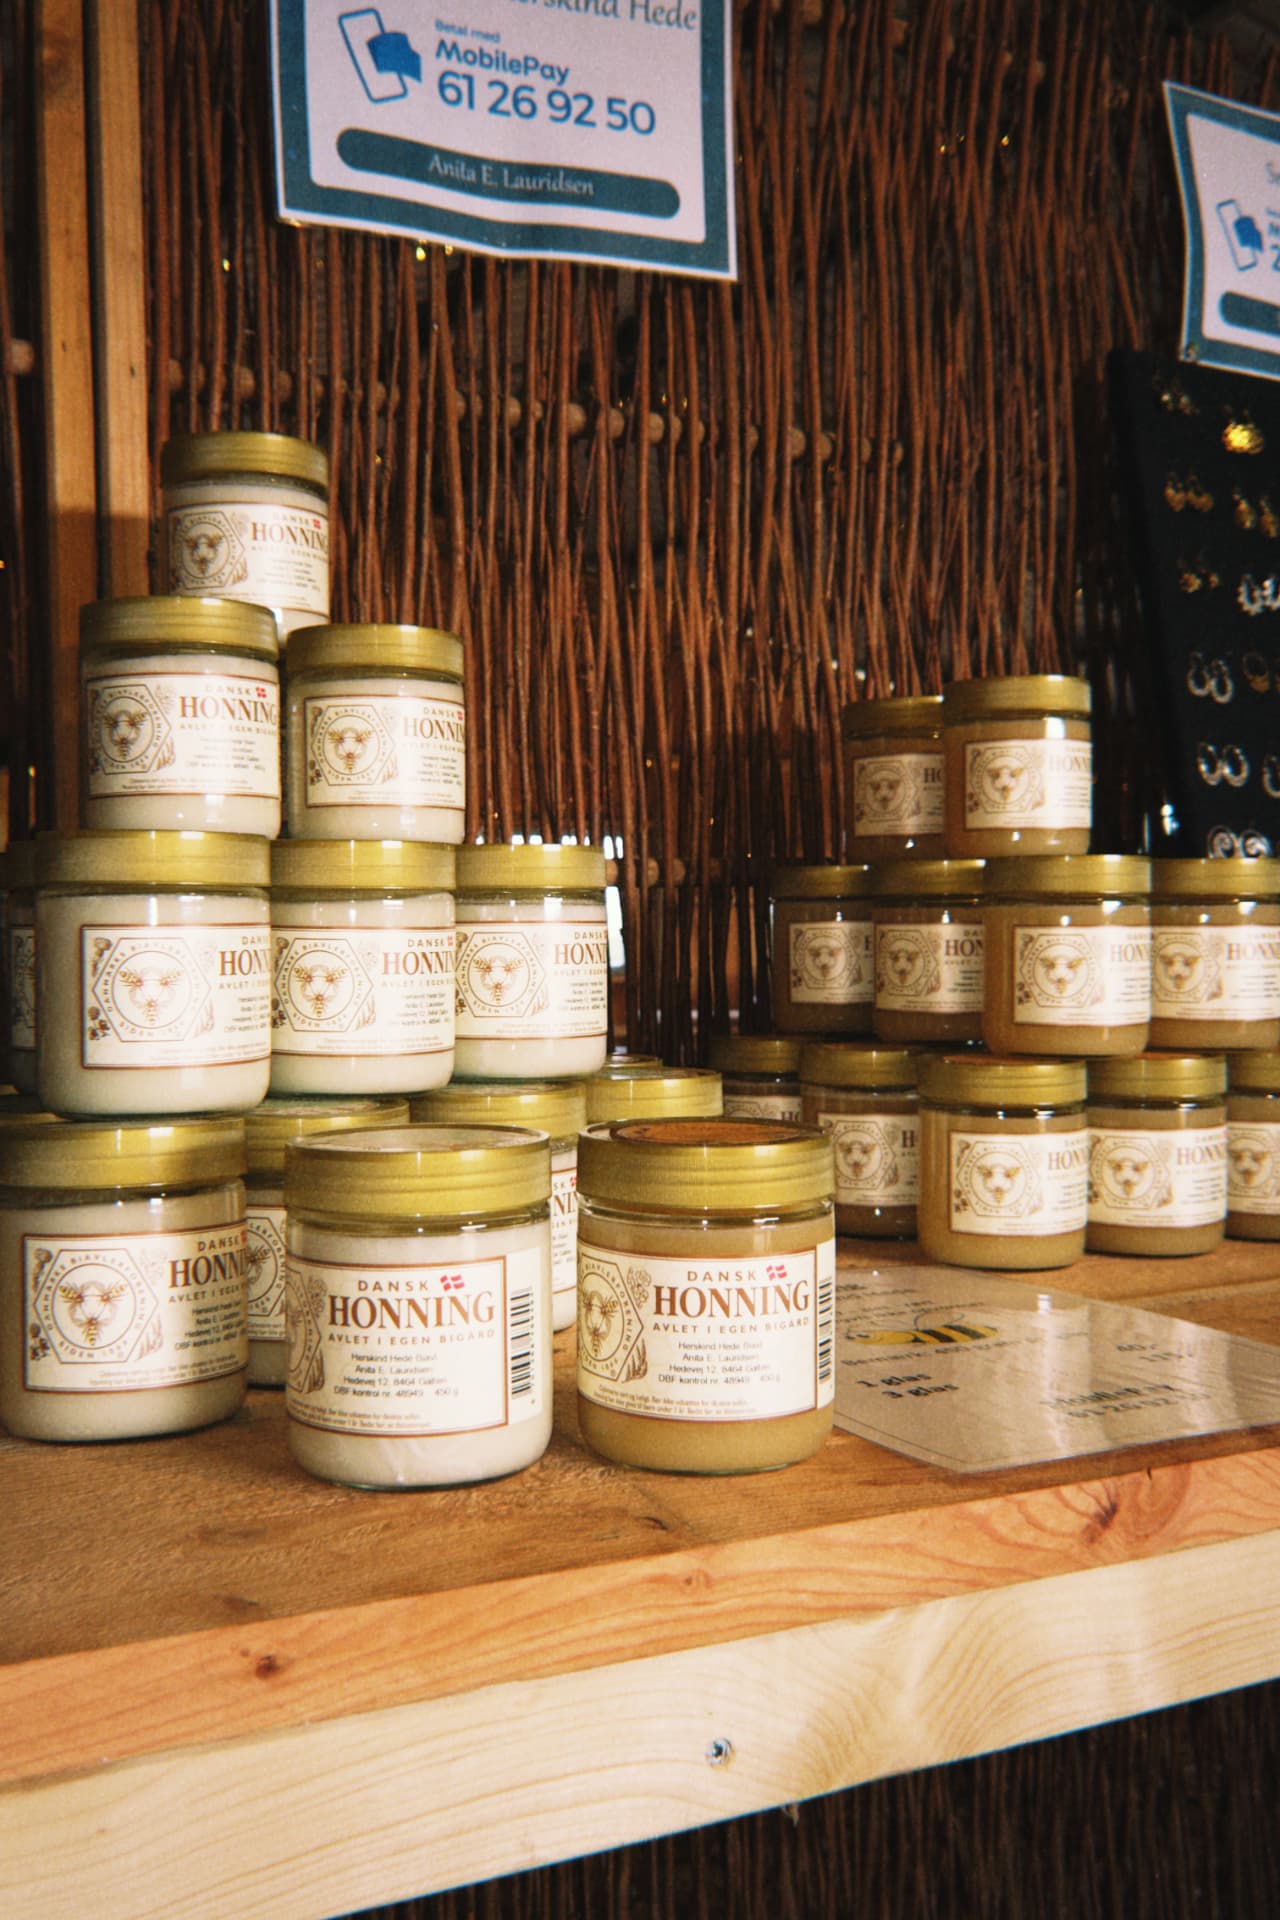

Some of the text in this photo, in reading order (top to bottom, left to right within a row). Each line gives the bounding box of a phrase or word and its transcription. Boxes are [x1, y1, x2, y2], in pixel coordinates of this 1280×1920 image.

[435, 39, 570, 86] MobilePay
[437, 70, 656, 135] 61 26 92 50
[428, 154, 476, 182] Anita
[503, 168, 595, 195] Lauridsen
[357, 1279, 429, 1292] DANSK
[687, 1270, 757, 1282] DANSK
[168, 1290, 207, 1303] AVLET
[328, 1290, 495, 1329] HONNING
[653, 1279, 810, 1319] HONNING
[328, 1333, 370, 1345] AVLET
[377, 1335, 382, 1345] I
[390, 1336, 431, 1345] EGEN
[652, 1321, 698, 1334] AVLET
[707, 1325, 711, 1334] I
[719, 1323, 758, 1334] EGEN
